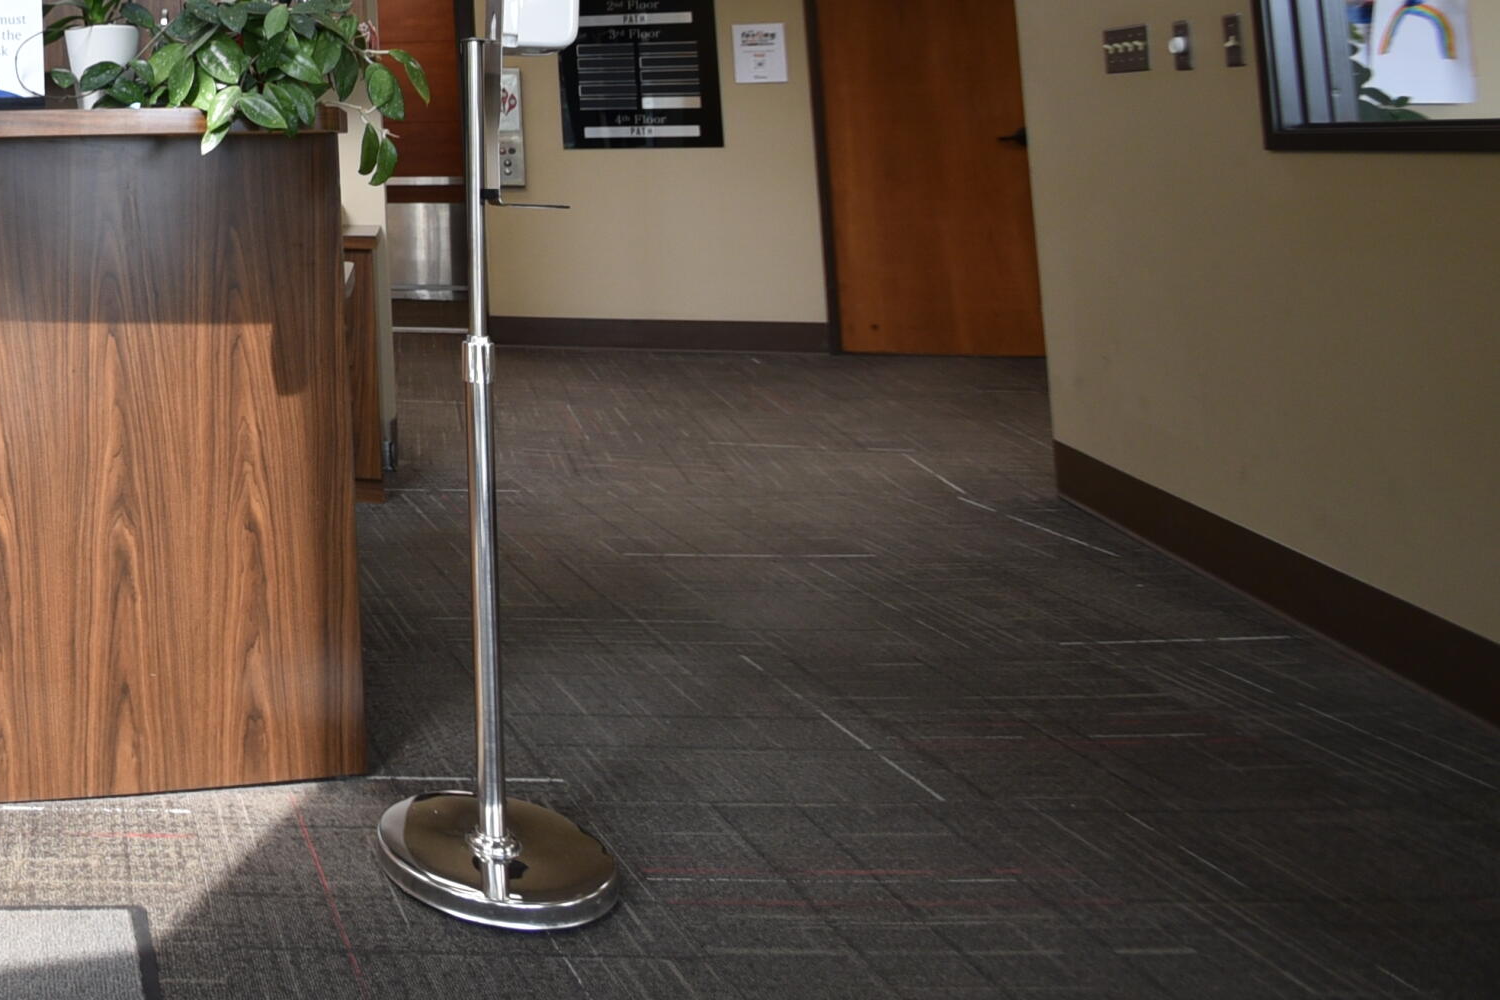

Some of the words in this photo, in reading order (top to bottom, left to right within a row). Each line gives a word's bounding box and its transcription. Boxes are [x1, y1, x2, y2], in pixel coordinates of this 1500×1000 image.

[628, 0, 660, 10] Floor
[623, 14, 646, 24] PATH
[1, 29, 22, 41] the
[628, 28, 661, 39] Floor
[634, 113, 667, 124] Floor
